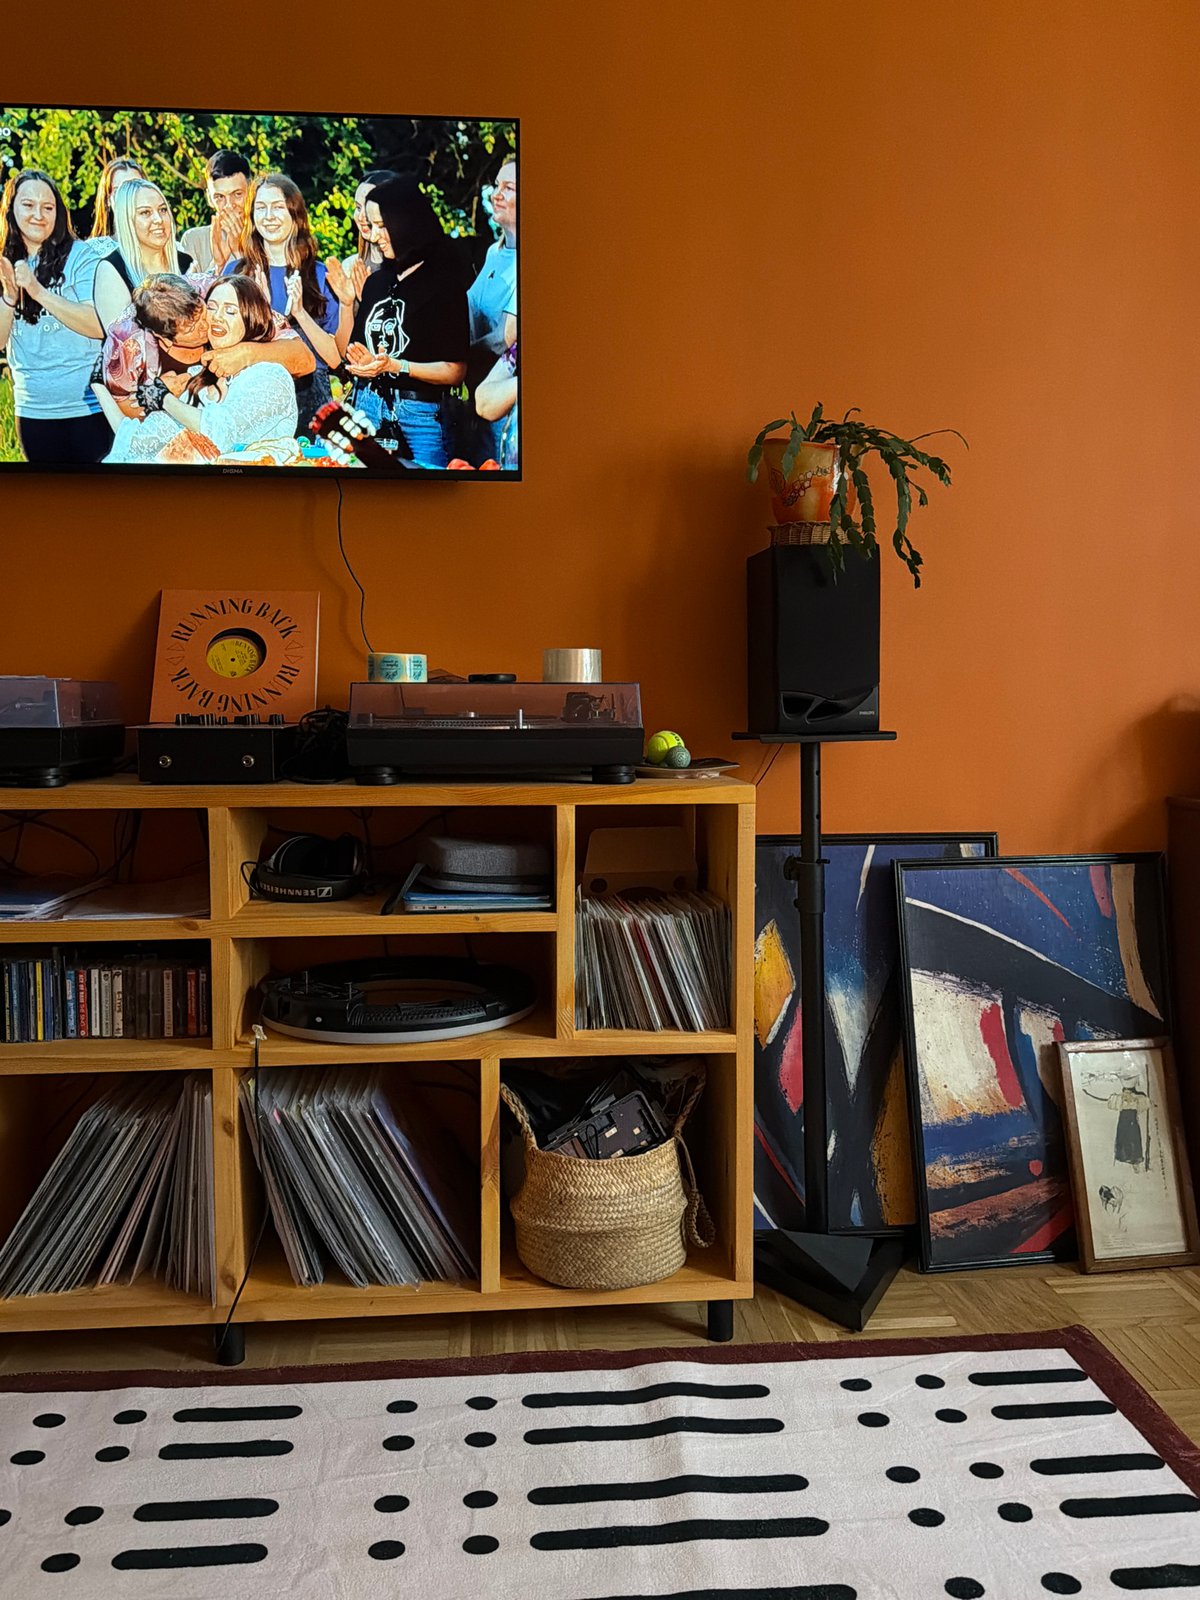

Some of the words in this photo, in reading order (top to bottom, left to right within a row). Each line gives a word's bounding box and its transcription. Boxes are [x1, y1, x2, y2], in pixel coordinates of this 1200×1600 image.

[170, 598, 253, 642] RUNNING
[255, 602, 301, 639] BACK
[168, 667, 214, 708] BACK
[217, 663, 300, 713] RUNNING
